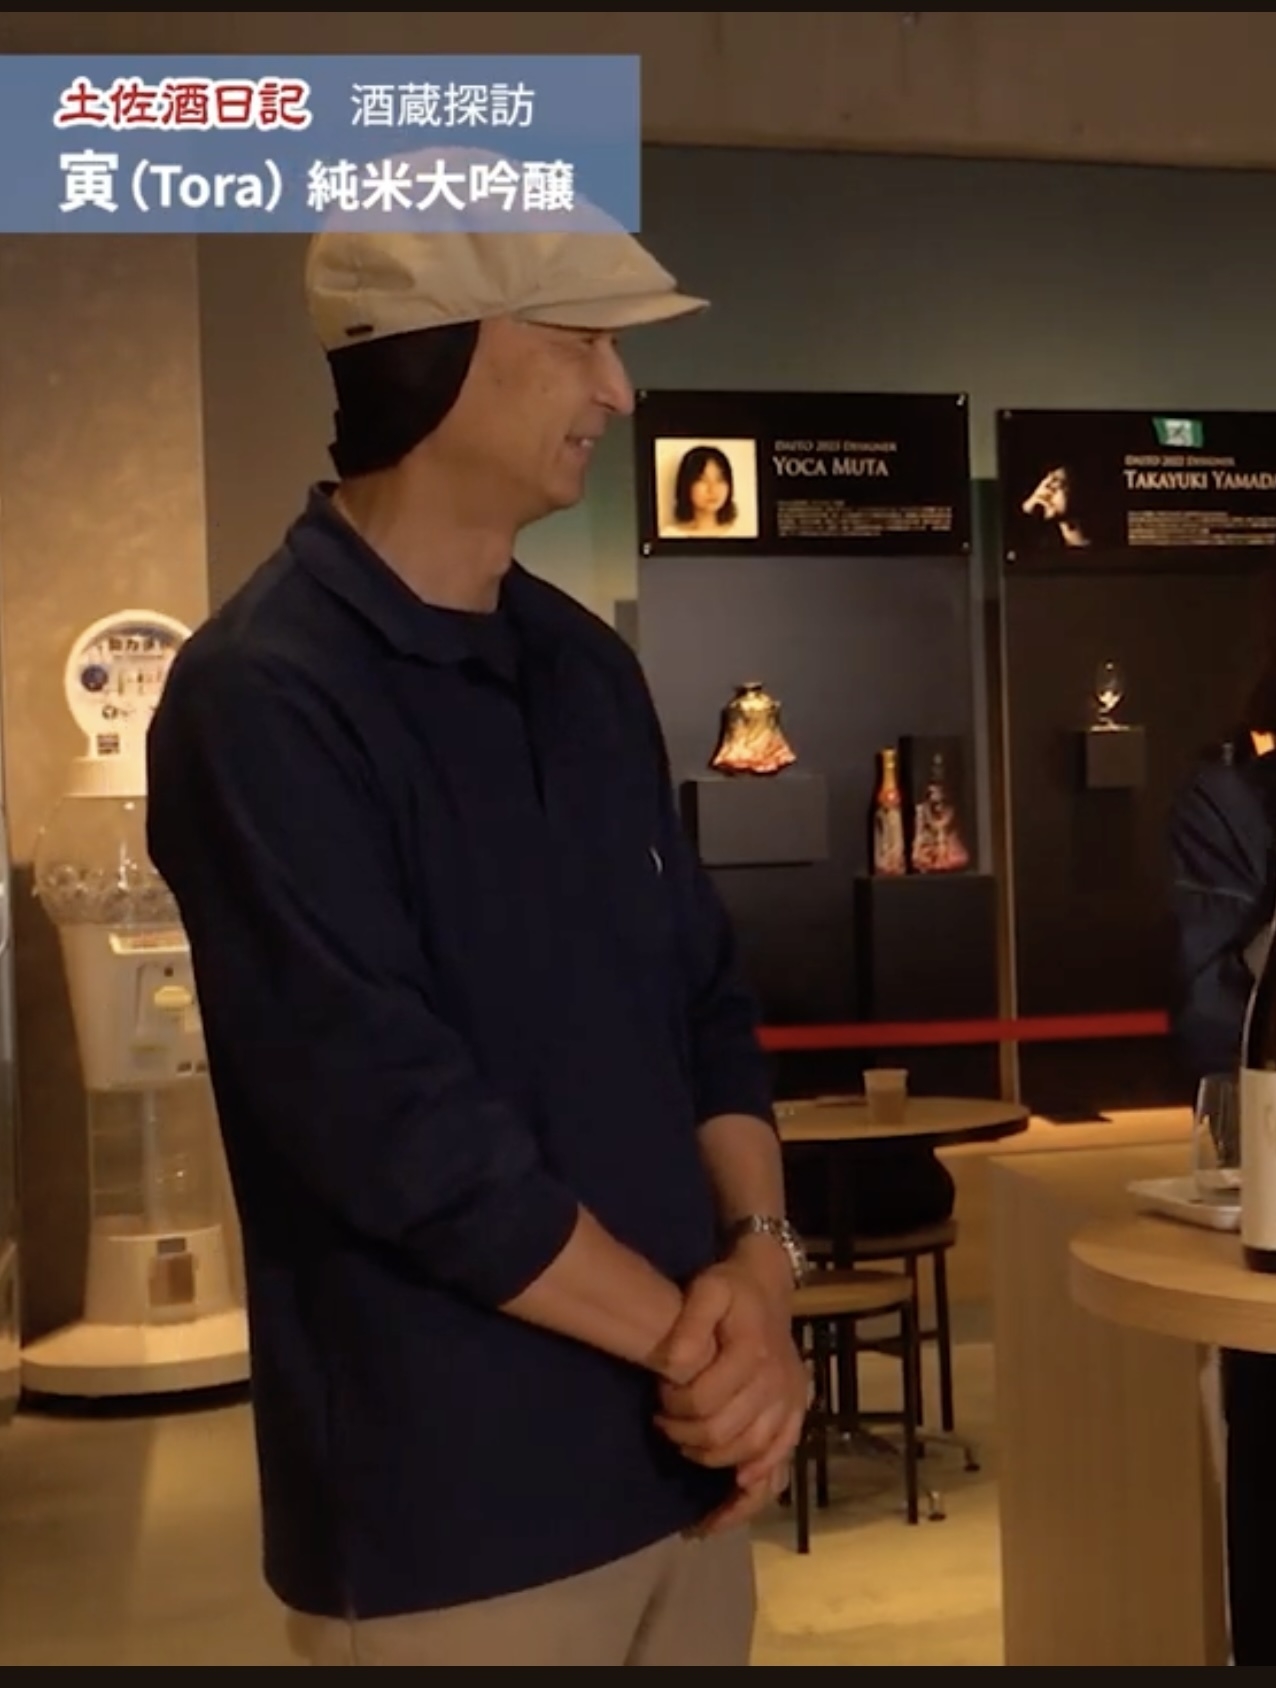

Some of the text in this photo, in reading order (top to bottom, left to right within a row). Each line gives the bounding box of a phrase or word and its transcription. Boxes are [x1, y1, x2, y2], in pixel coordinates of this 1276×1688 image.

[772, 455, 889, 477] YOCA MUTA
[1123, 469, 1209, 490] TAKAYUKI
